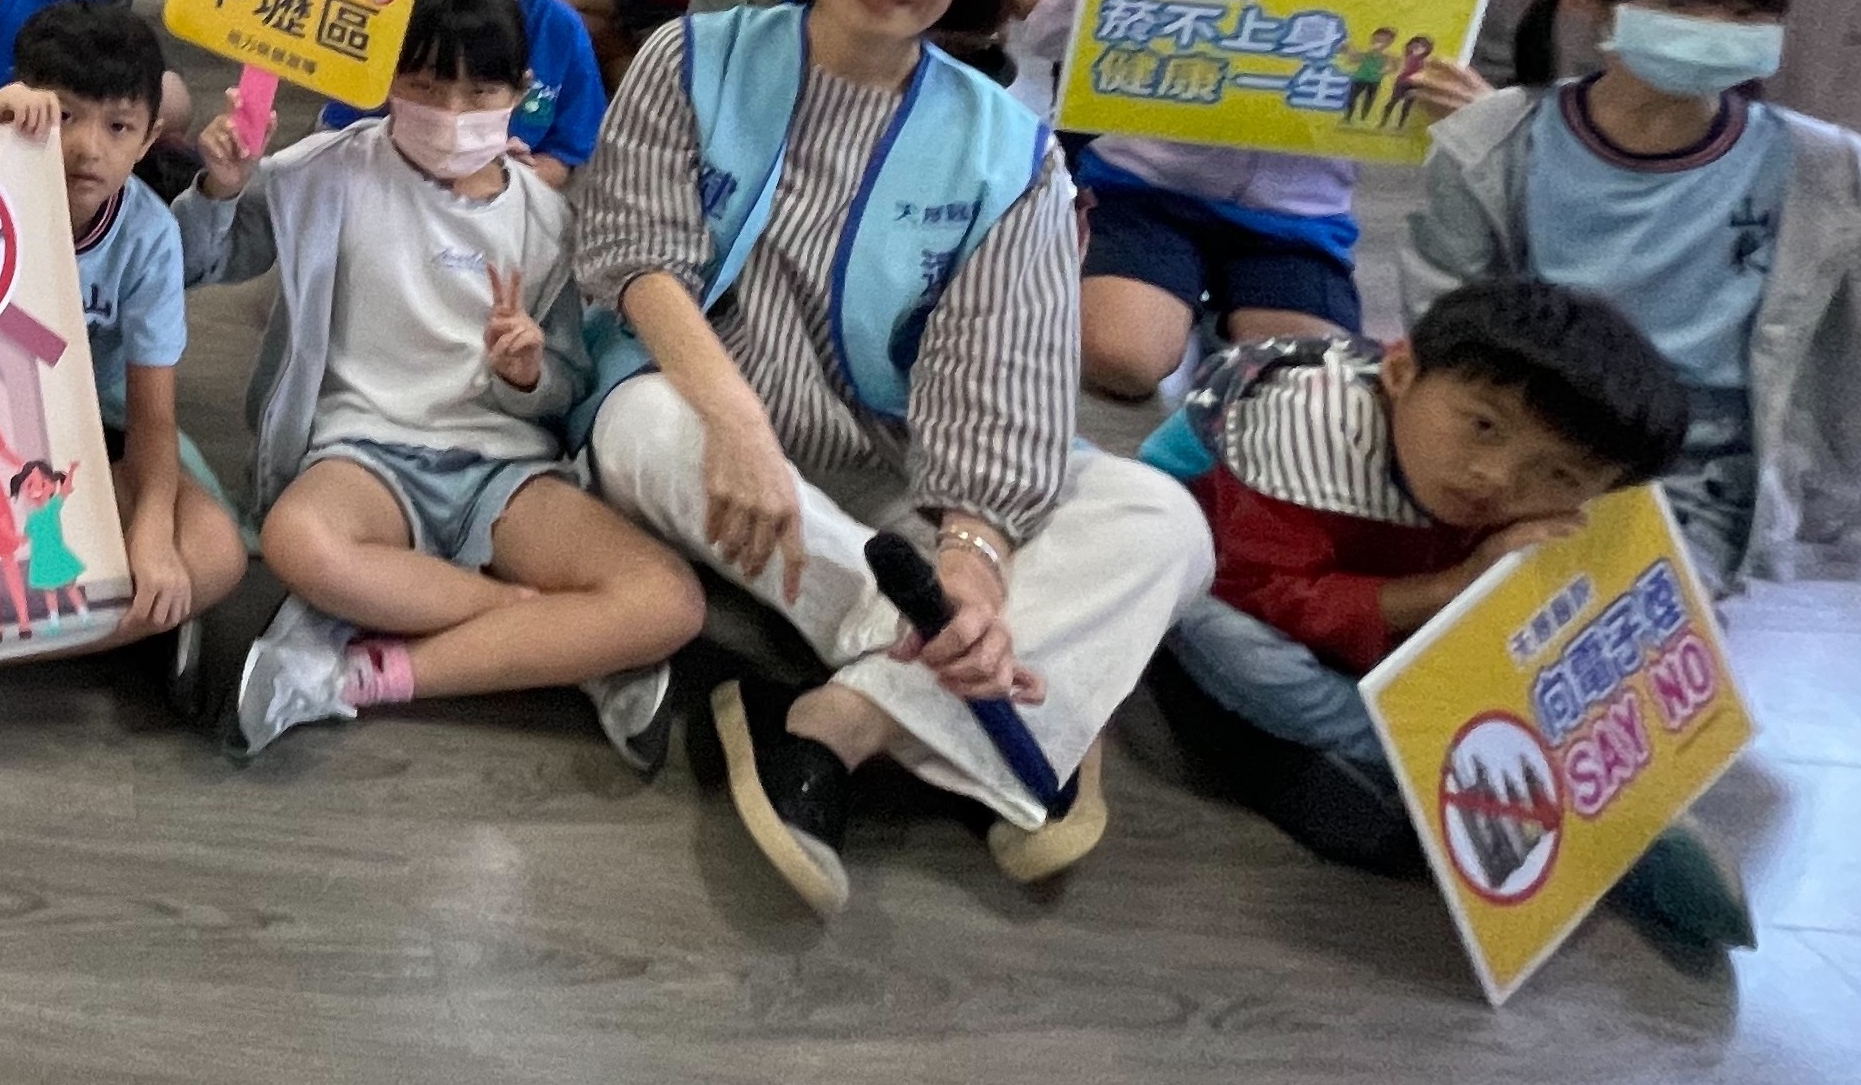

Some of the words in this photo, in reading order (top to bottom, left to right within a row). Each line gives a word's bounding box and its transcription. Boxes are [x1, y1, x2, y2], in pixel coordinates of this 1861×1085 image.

[1094, 47, 1349, 112] 健康一生
[1566, 693, 1649, 814] SAY
[1650, 634, 1714, 728] NO
